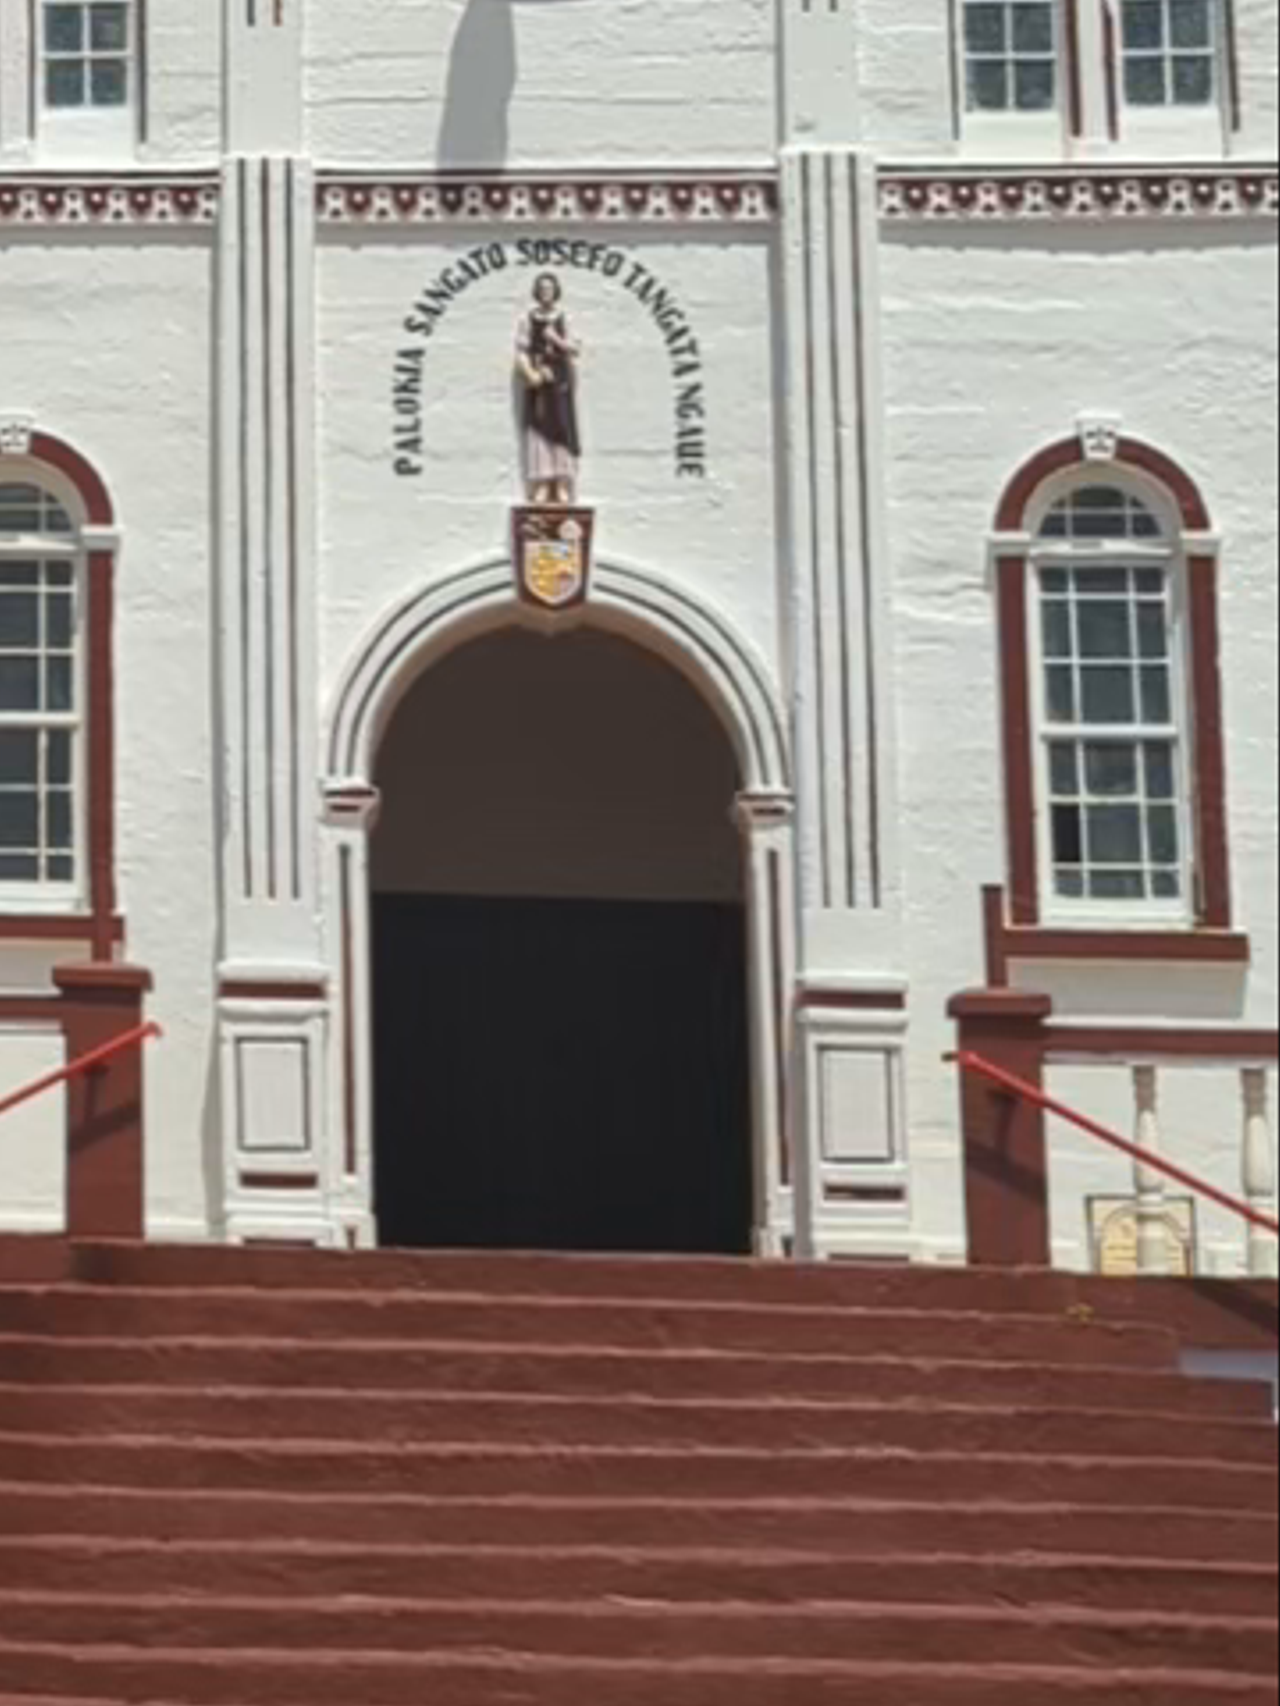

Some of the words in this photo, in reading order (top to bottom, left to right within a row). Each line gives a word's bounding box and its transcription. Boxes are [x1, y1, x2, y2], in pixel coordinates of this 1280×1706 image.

[404, 242, 508, 337] SANGATO
[514, 238, 624, 276] SOSEFO
[623, 265, 703, 377] TANGATA
[393, 348, 426, 477] PALOKIA
[673, 381, 705, 479] NGAUE
